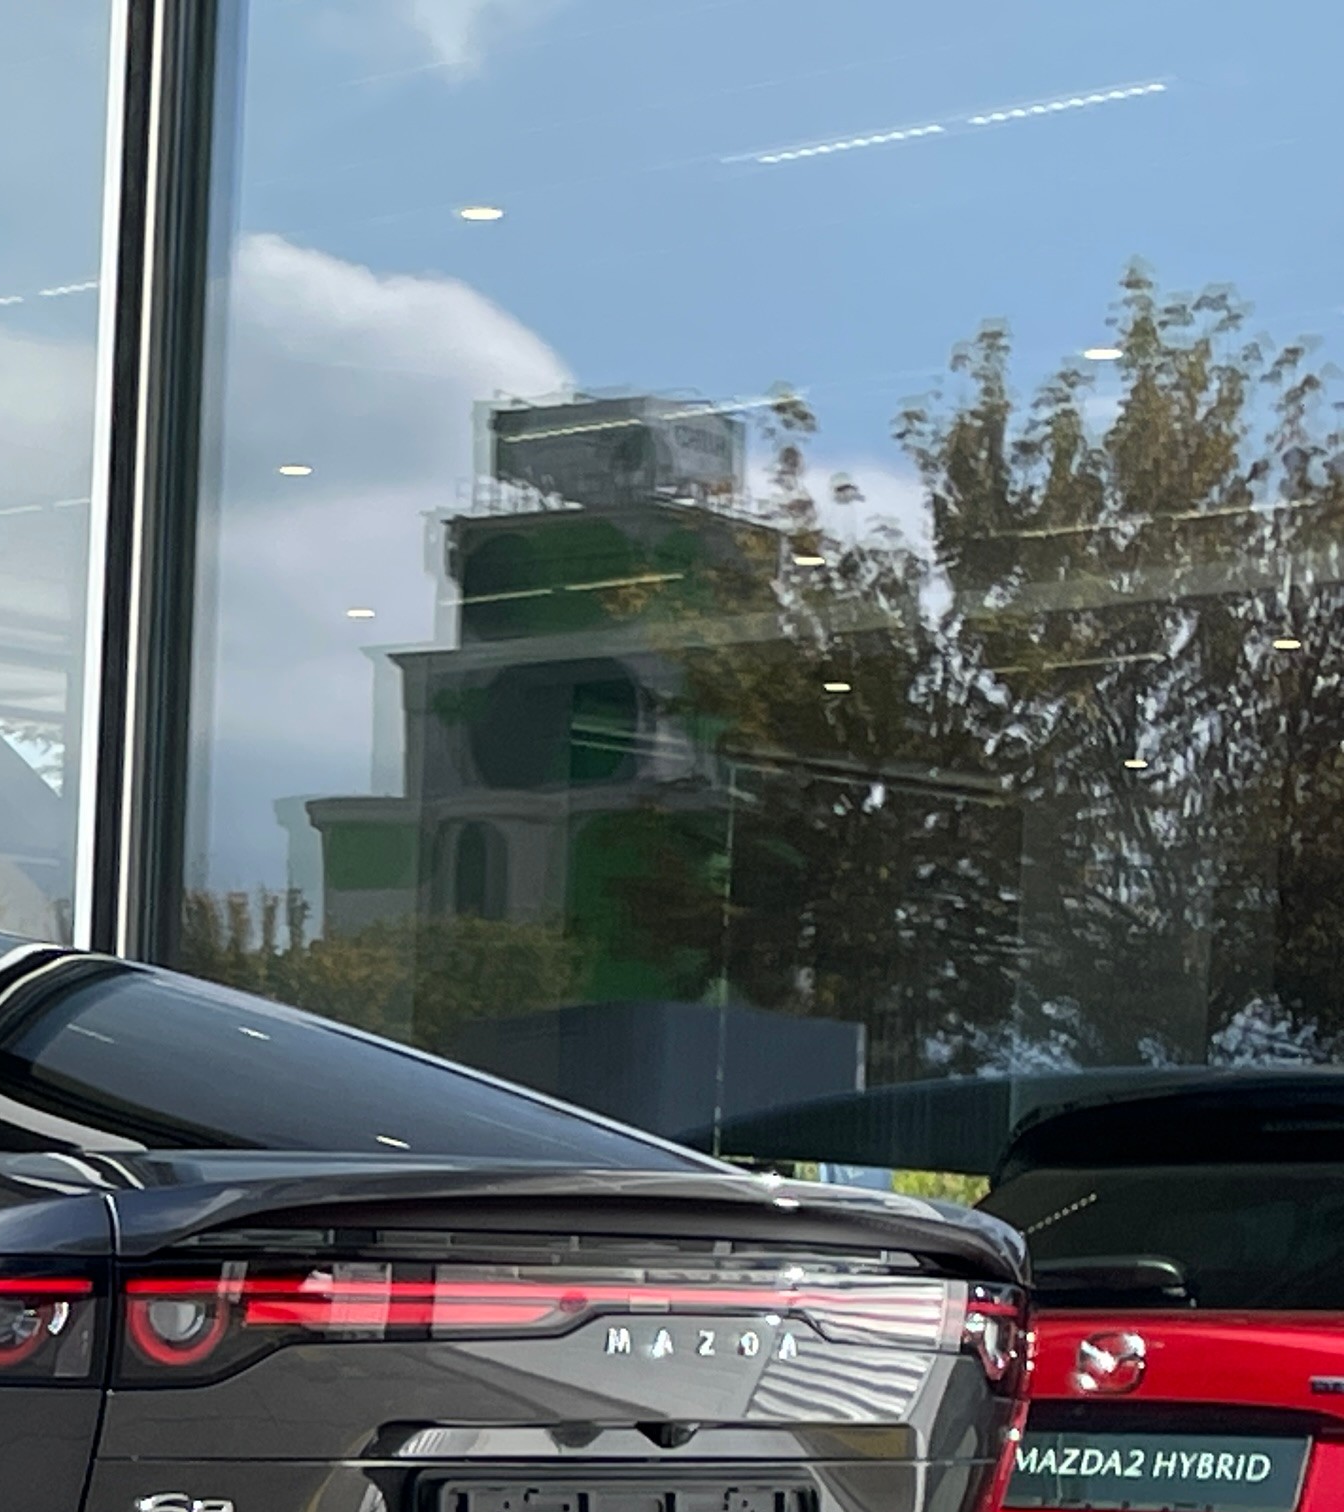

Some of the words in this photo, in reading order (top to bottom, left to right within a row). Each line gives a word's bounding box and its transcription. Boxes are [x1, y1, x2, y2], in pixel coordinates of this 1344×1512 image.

[606, 1327, 798, 1360] MAZDA
[1015, 1447, 1145, 1478] MAZDA2
[1152, 1451, 1271, 1481] HYBRID
